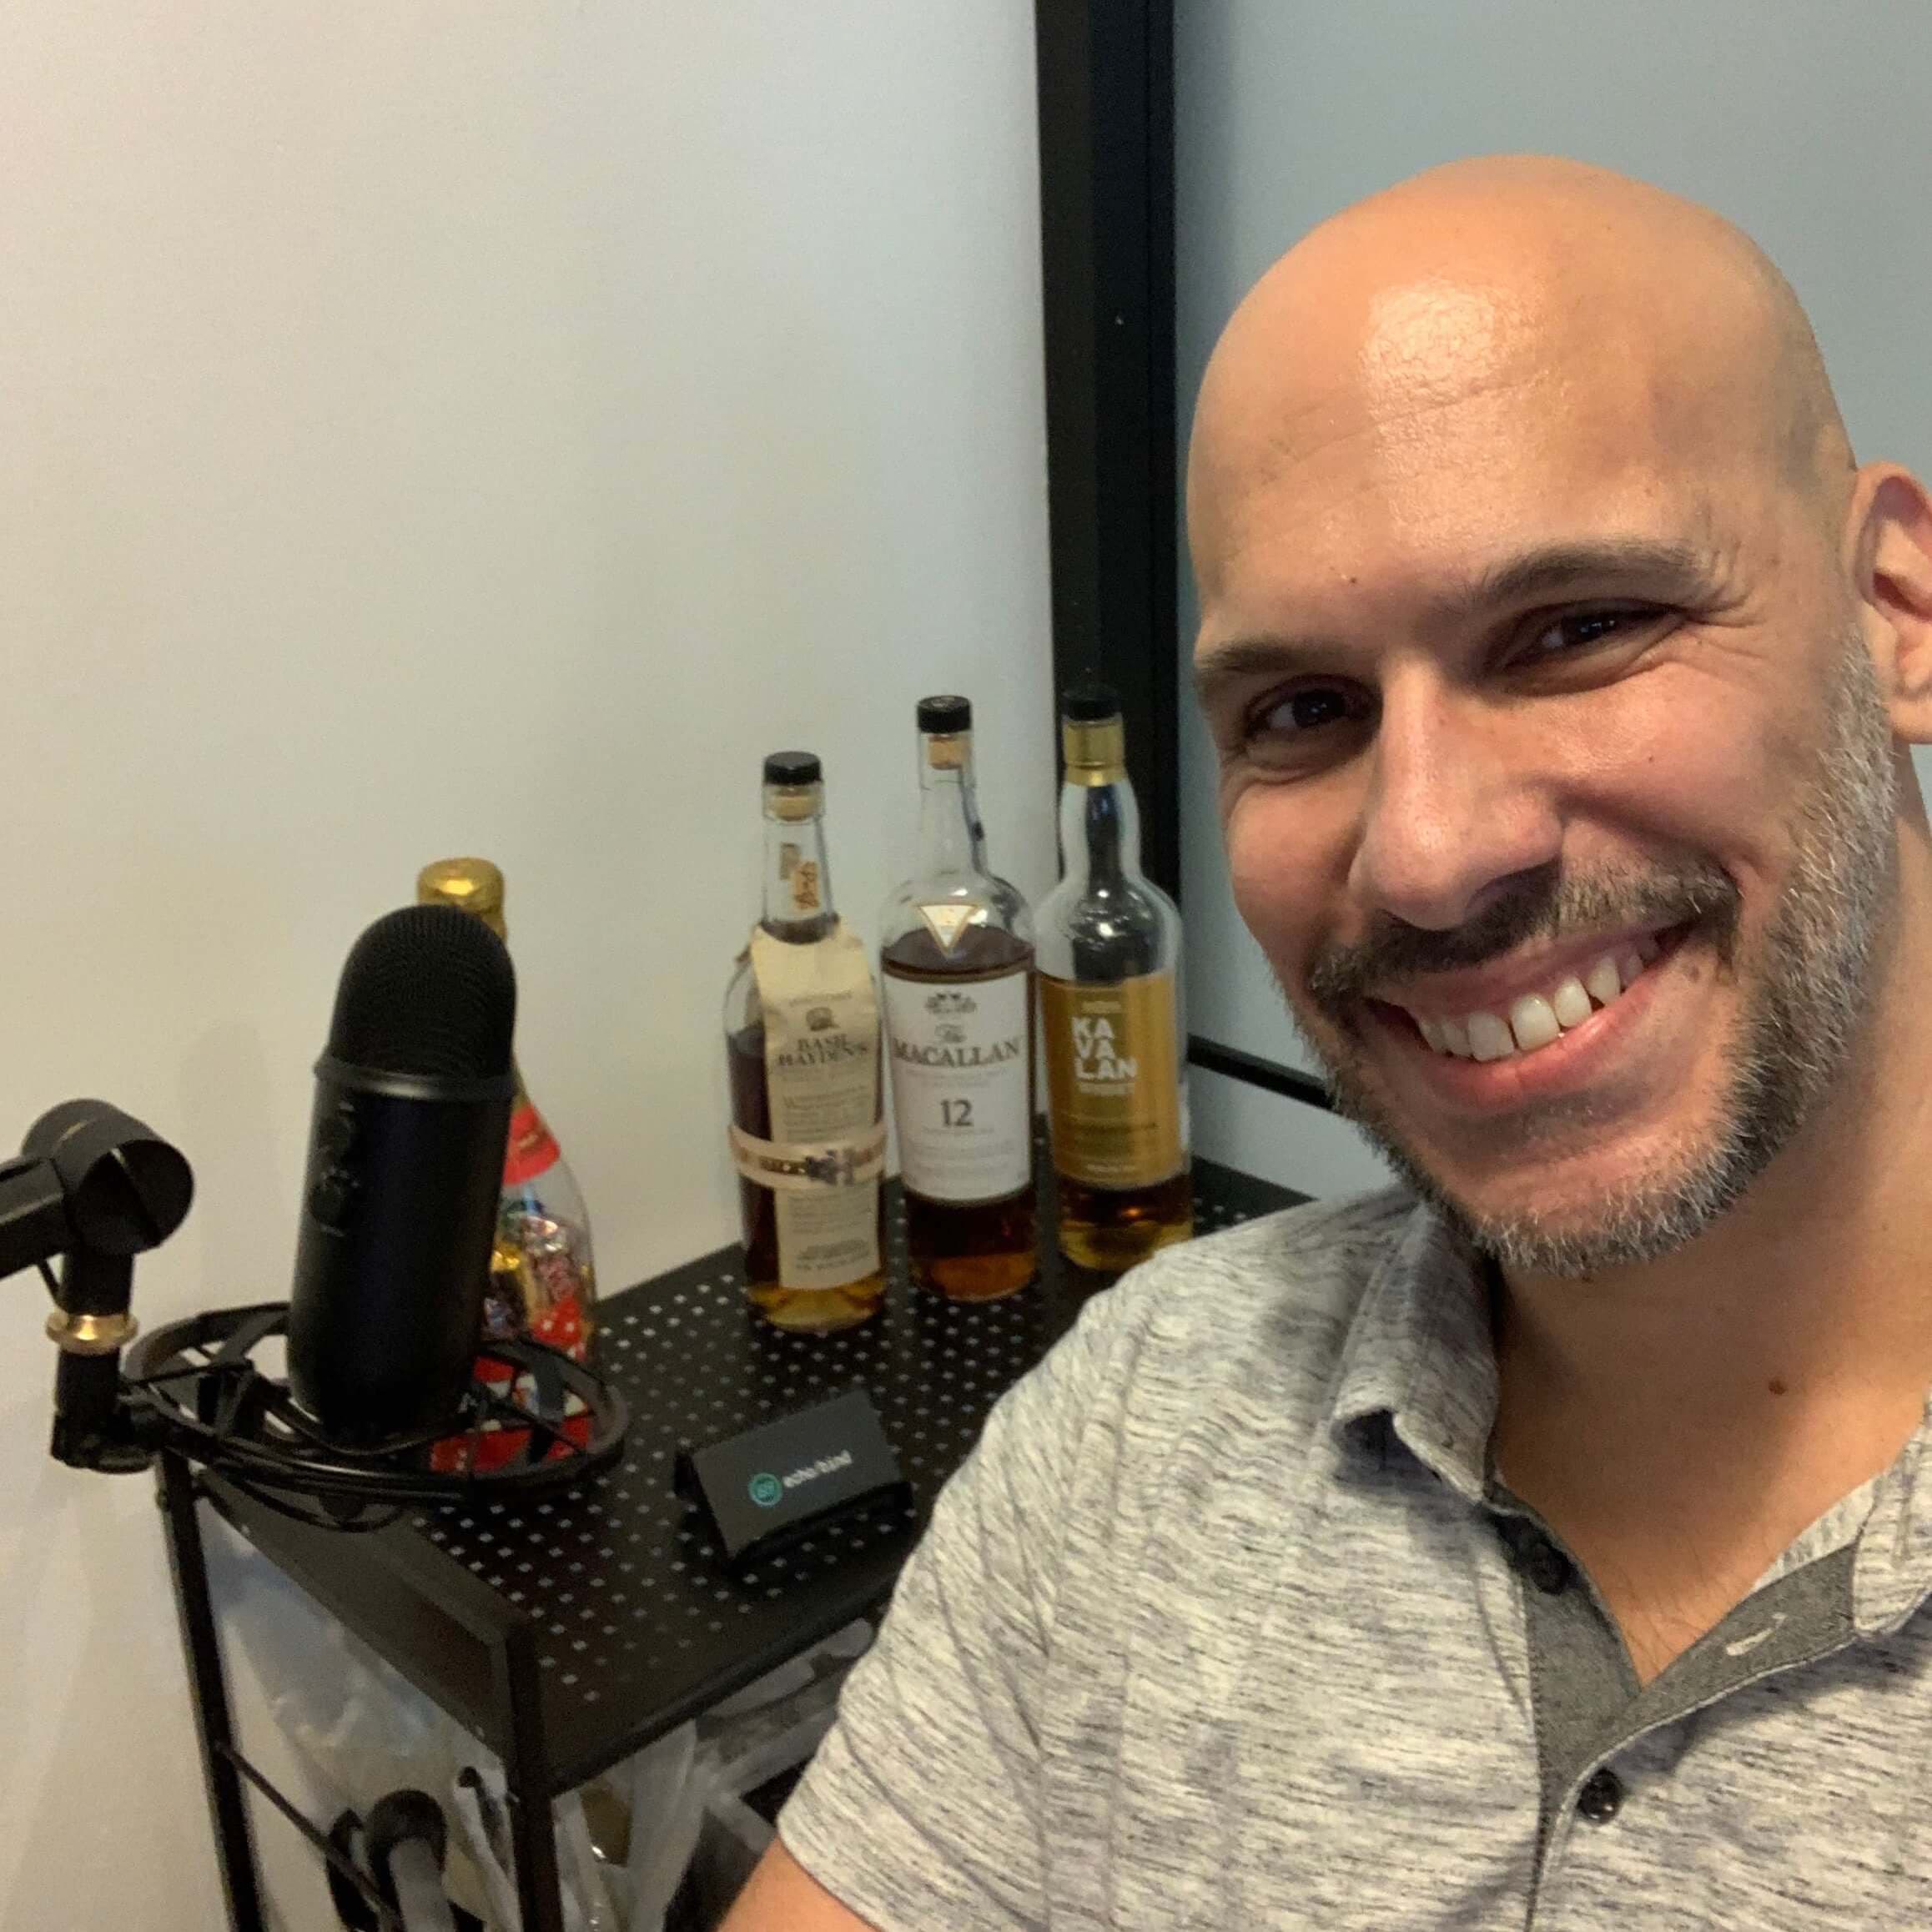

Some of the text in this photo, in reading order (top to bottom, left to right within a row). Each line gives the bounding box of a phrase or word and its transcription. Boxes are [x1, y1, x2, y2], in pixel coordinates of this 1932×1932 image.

[893, 1037, 1023, 1068] MACALLAN
[1074, 1056, 1140, 1079] LAN
[940, 1099, 974, 1128] 12
